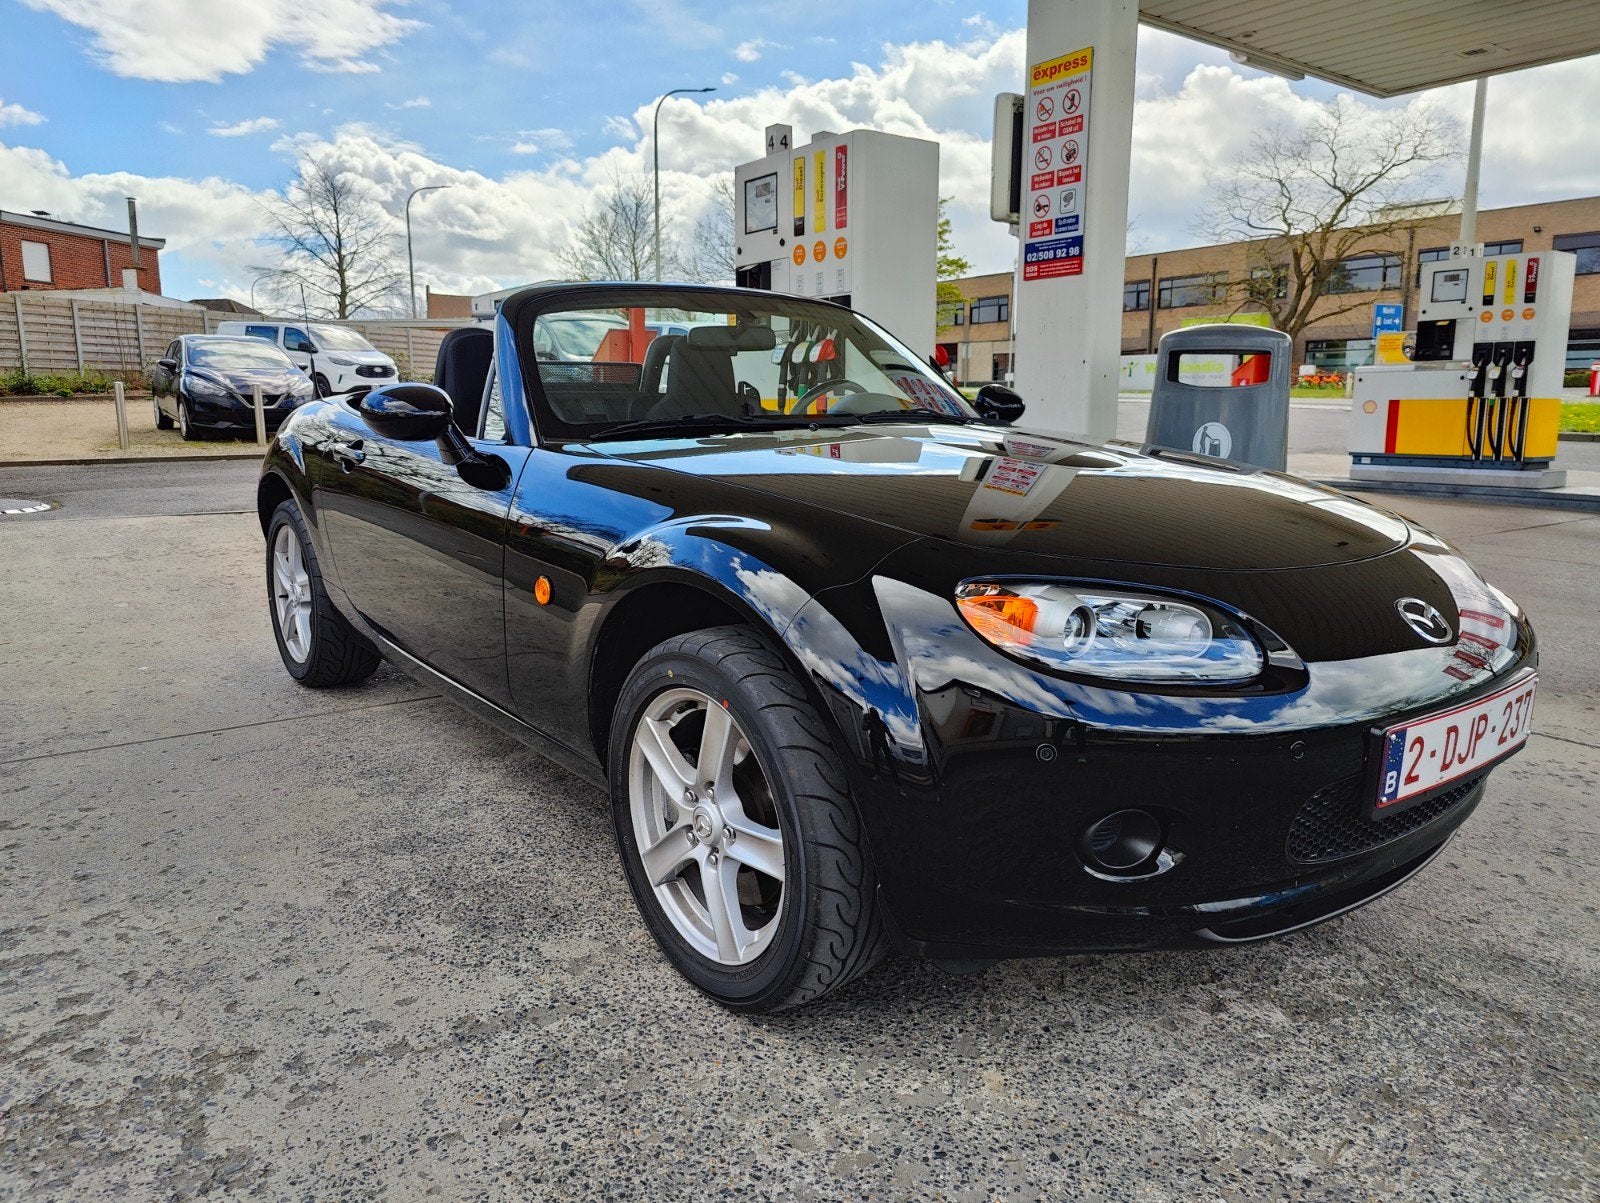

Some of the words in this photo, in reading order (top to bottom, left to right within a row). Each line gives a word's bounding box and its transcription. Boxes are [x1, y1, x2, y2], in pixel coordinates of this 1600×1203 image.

[1033, 55, 1088, 81] express
[768, 134, 774, 149] 4
[780, 134, 788, 149] 4
[1026, 250, 1054, 262] 02/508
[1056, 248, 1067, 258] 92
[1068, 246, 1080, 256] 98
[1453, 246, 1460, 255] 2
[1470, 248, 1474, 256] 1
[1385, 771, 1397, 794] B
